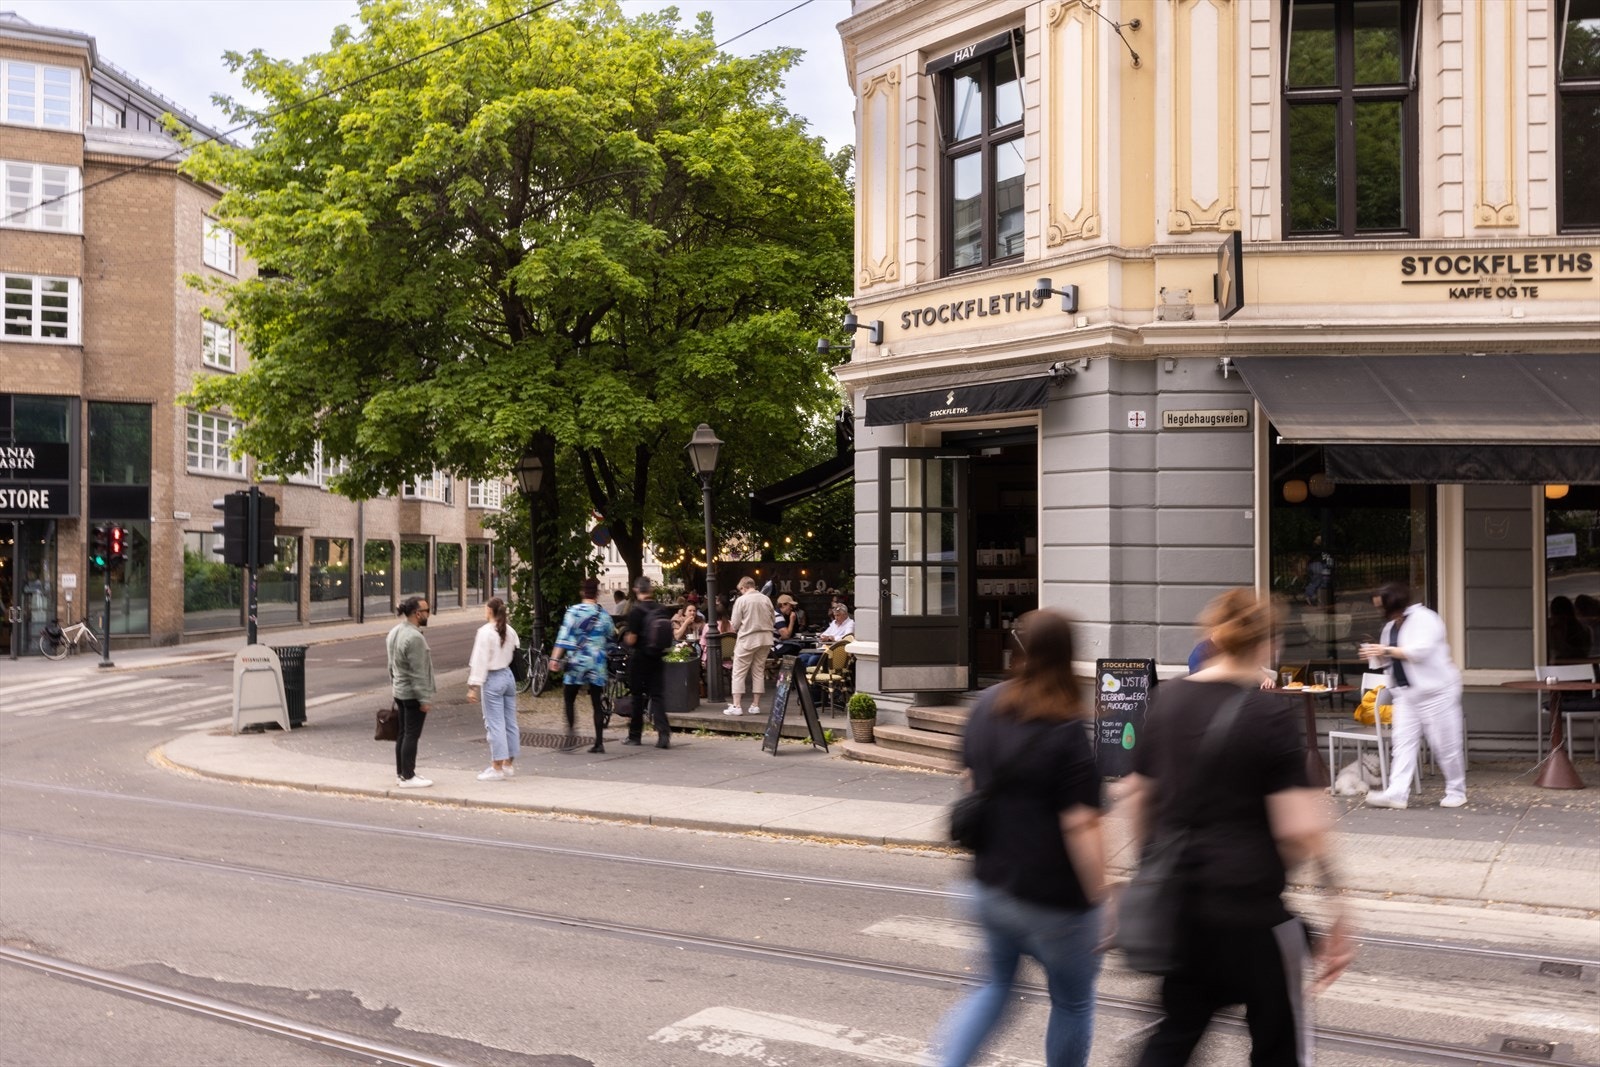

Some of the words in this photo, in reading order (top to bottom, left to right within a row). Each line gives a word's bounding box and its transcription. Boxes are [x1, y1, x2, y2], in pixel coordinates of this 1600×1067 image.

[953, 44, 977, 63] HAY
[1400, 252, 1593, 276] STOCKFLETHS
[1449, 286, 1492, 299] KAFFE
[1496, 286, 1518, 298] OG
[1521, 286, 1539, 298] TE
[929, 406, 969, 418] STOCKFLETHS
[1167, 412, 1244, 427] Hegdehaugsveien
[0, 489, 50, 509] STORE
[1133, 692, 1145, 701] EGG
